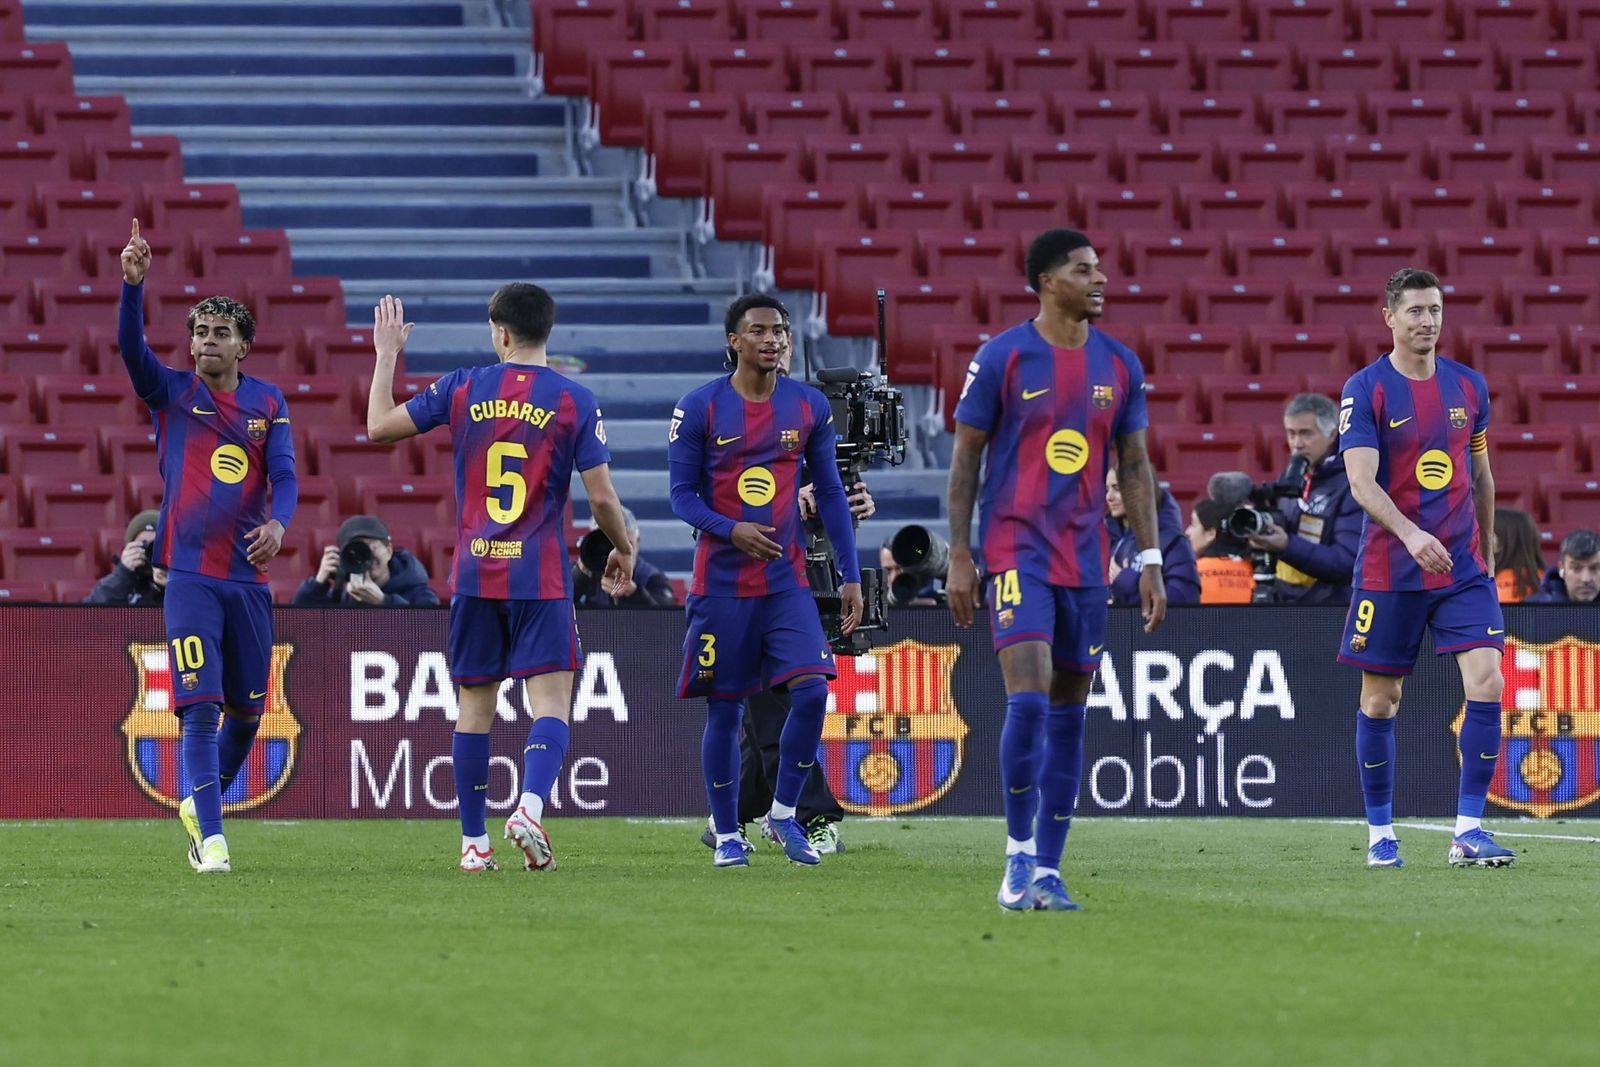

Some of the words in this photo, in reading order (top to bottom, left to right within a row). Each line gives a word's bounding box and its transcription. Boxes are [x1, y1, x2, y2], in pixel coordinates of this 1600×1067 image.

[470, 400, 556, 429] CUBARSÍ
[486, 441, 529, 525] 5
[490, 540, 523, 549] UNHCR
[490, 548, 522, 556] ACNUR
[993, 569, 1022, 611] 14
[1355, 598, 1376, 634] 9
[172, 634, 205, 673] 10
[698, 632, 717, 667] 3
[351, 652, 628, 721] BAA
[1085, 650, 1296, 735] ARÇA
[1089, 731, 1278, 810] obile
